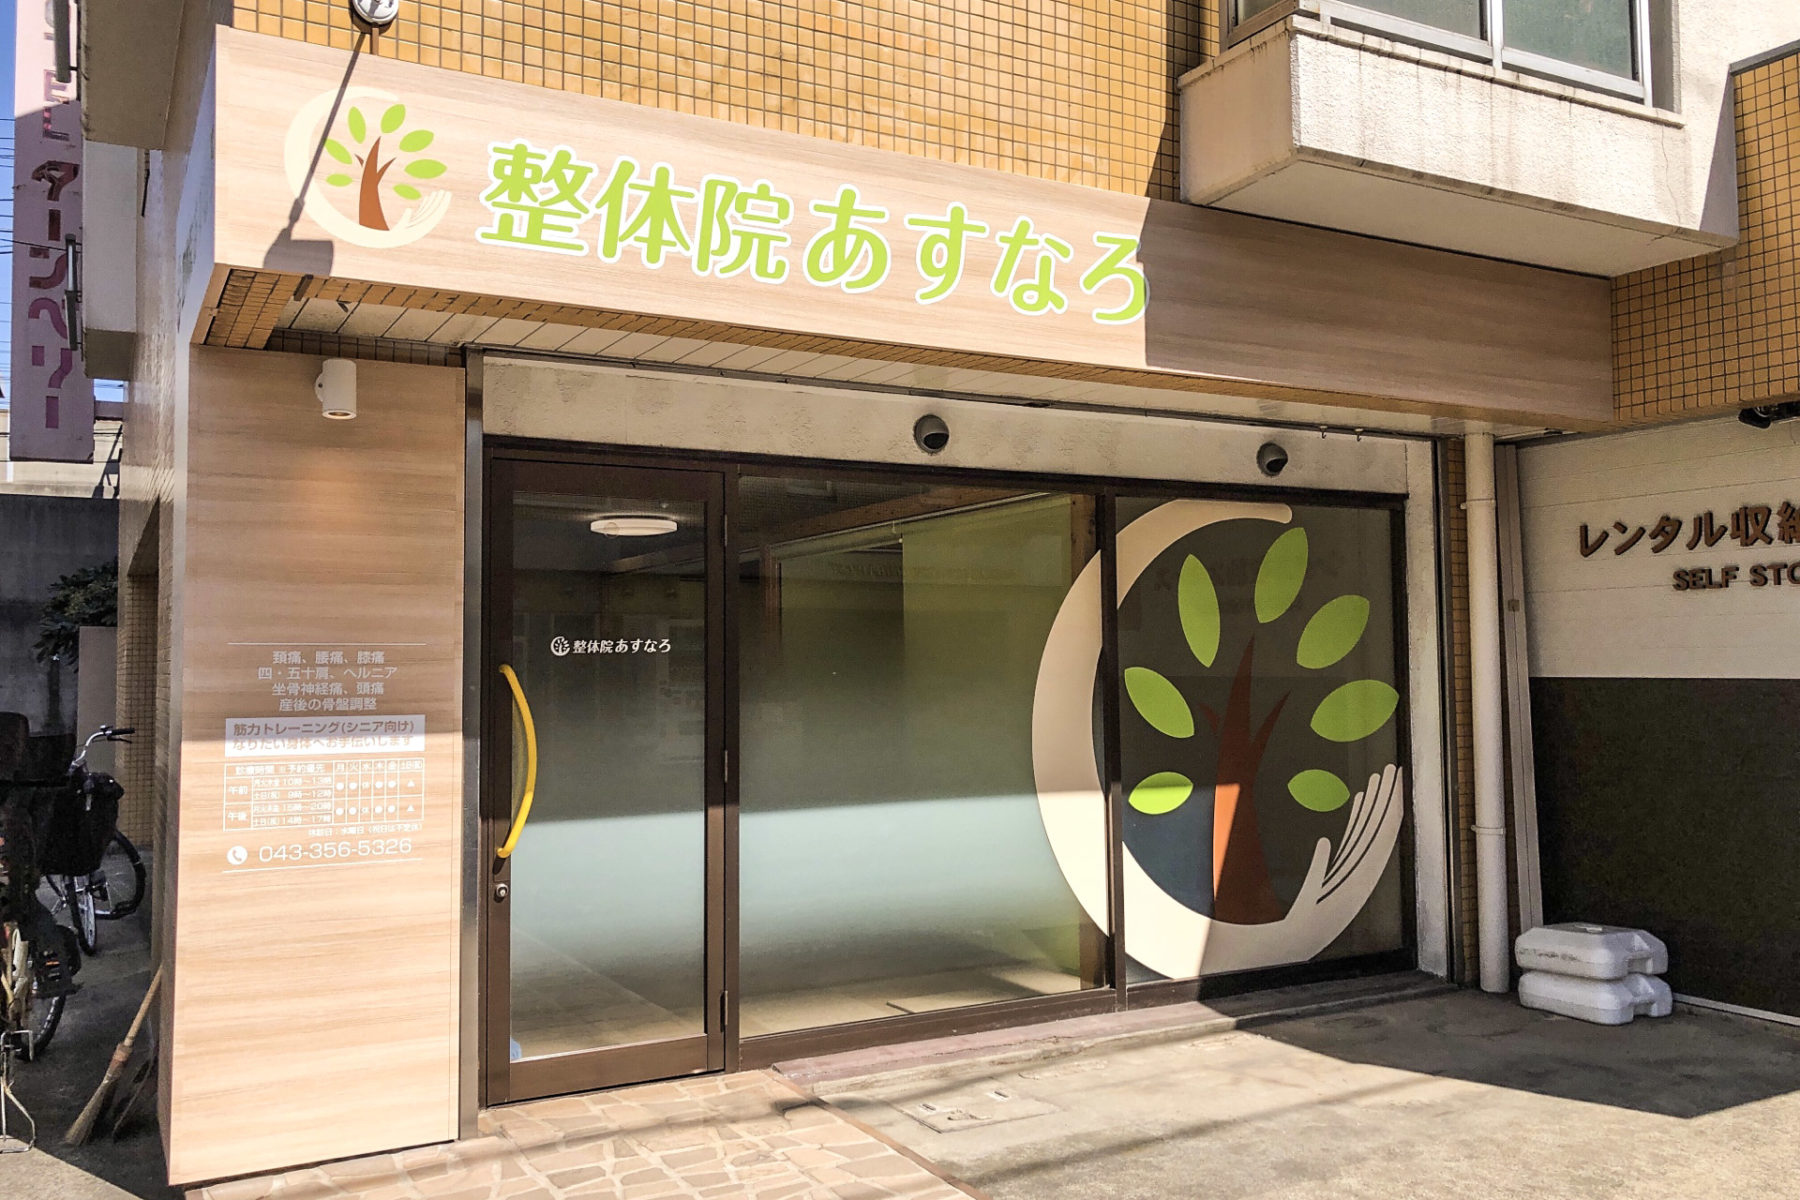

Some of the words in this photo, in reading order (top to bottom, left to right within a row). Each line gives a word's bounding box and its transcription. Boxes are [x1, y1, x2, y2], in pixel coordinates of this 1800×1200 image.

[477, 140, 1148, 323] 整体院あすなろ
[1672, 566, 1740, 591] SELF
[572, 638, 672, 653] 整体院あすなろ
[272, 681, 385, 697] 坐骨神経痛、頭痛
[279, 697, 377, 712] 産後の骨盤調整
[258, 838, 412, 862] 043-356-5326
